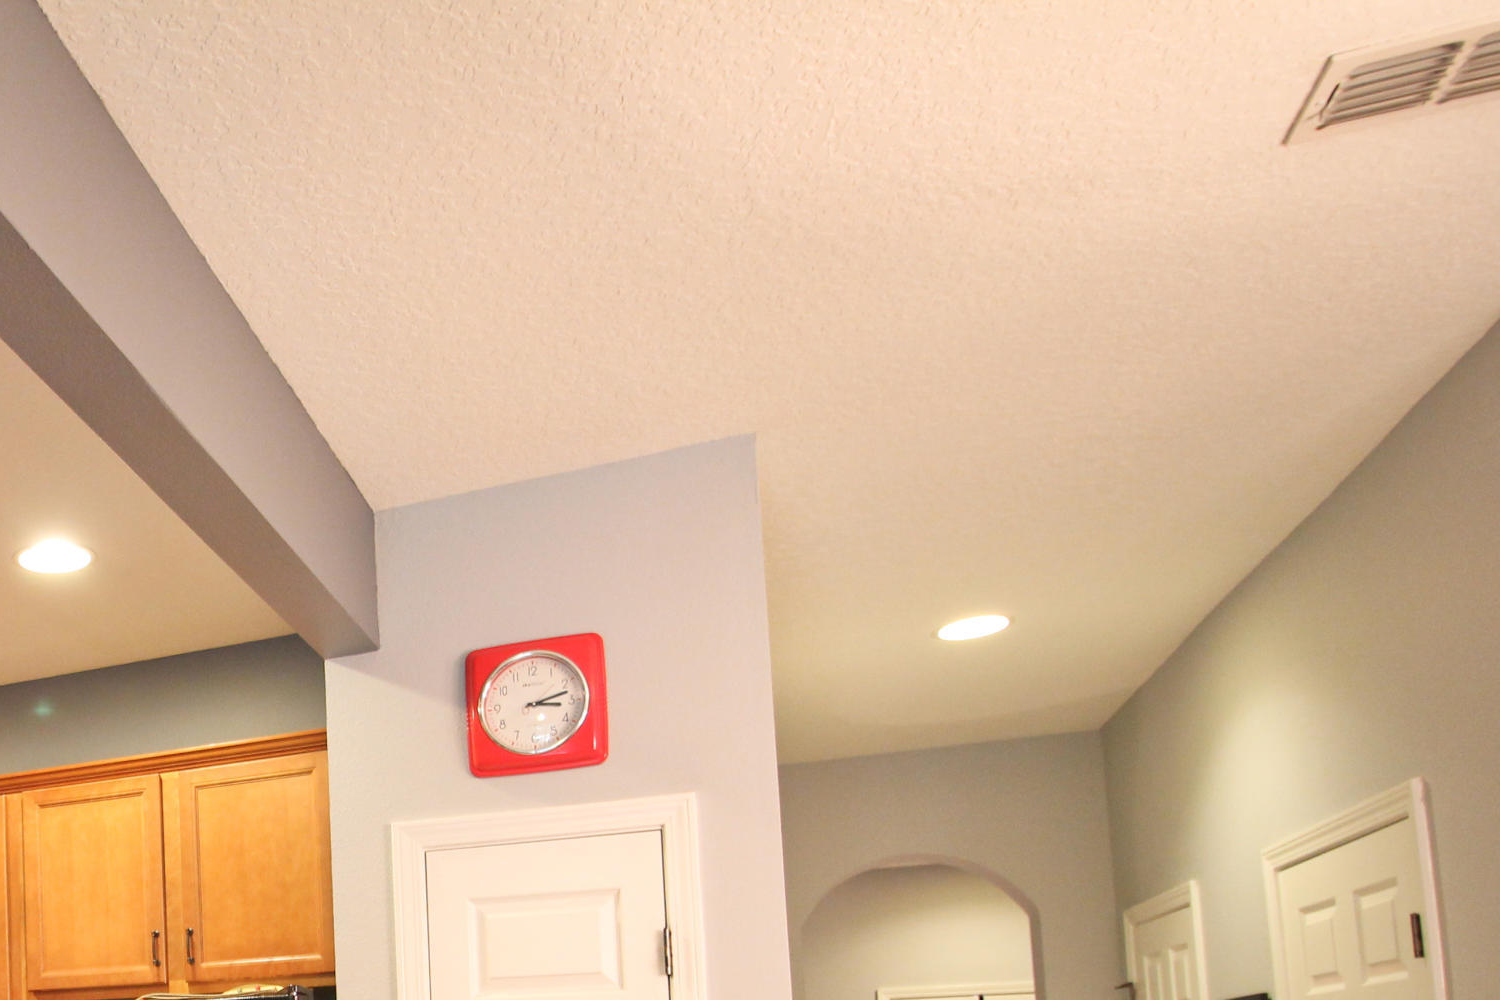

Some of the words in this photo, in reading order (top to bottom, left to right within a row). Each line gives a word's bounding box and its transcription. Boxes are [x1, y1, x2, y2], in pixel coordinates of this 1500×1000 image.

[528, 666, 537, 676] 12
[549, 667, 553, 677] 1
[513, 671, 519, 682] 11
[562, 679, 569, 690] 2
[500, 686, 507, 696] 10
[568, 695, 576, 705] 3
[494, 704, 500, 713] 9
[562, 712, 569, 722] 4
[500, 720, 506, 729] 8
[514, 730, 519, 740] 7
[550, 725, 557, 736] 5
